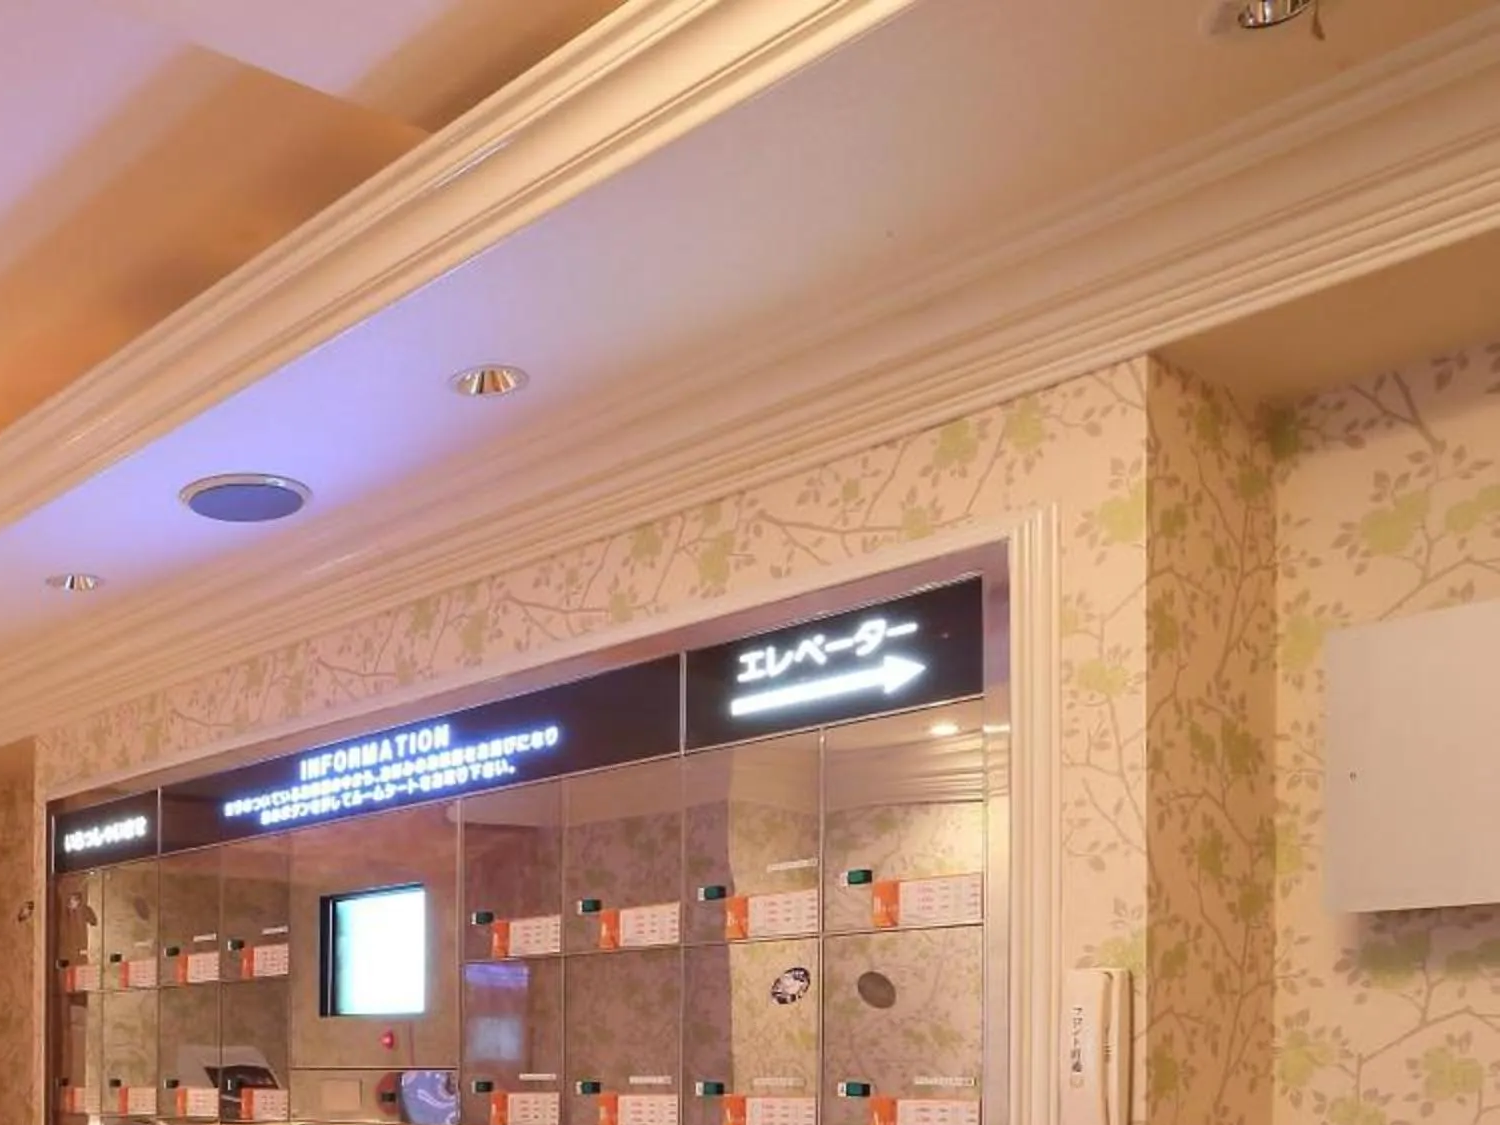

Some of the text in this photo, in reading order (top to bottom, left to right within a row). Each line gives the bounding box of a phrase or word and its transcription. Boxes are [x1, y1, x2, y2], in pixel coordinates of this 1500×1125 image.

[736, 618, 919, 684] エレベーター
[300, 723, 450, 782] INFORMATION
